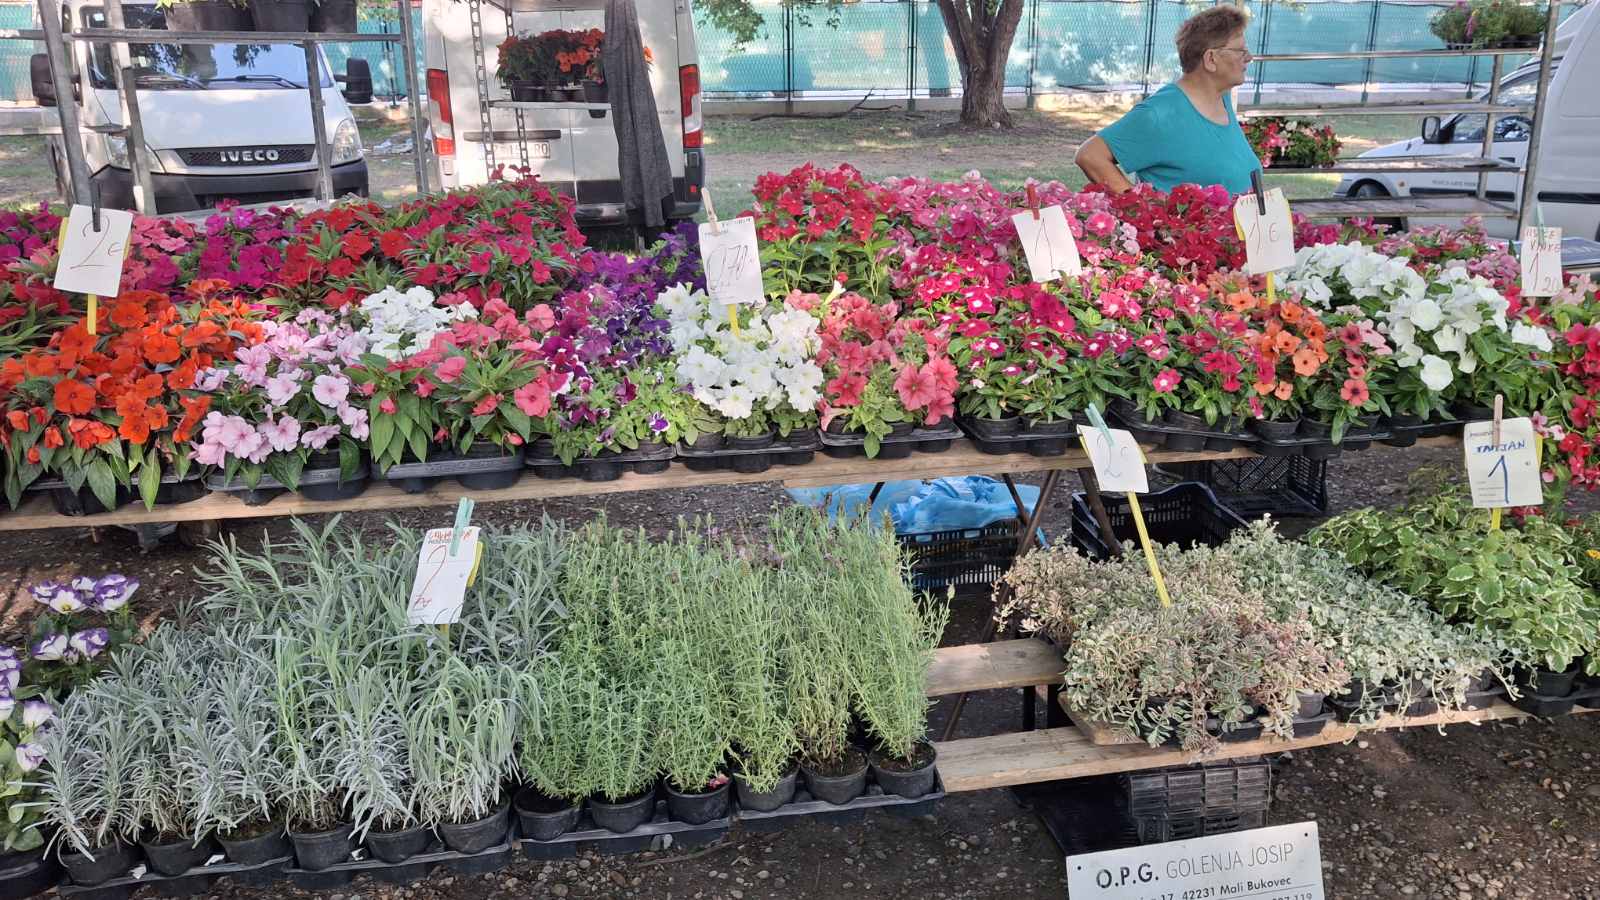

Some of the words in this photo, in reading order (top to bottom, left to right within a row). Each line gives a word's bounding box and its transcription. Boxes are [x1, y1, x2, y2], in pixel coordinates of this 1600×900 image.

[219, 149, 279, 162] IVECO
[1487, 454, 1510, 504] 1
[1096, 862, 1160, 889] O.P.G.
[1166, 850, 1244, 879] GOLENJA
[1247, 843, 1294, 867] JOSIP
[1182, 887, 1215, 900] 42231
[1220, 882, 1244, 896] Mali
[1246, 877, 1292, 892] Bukovec
